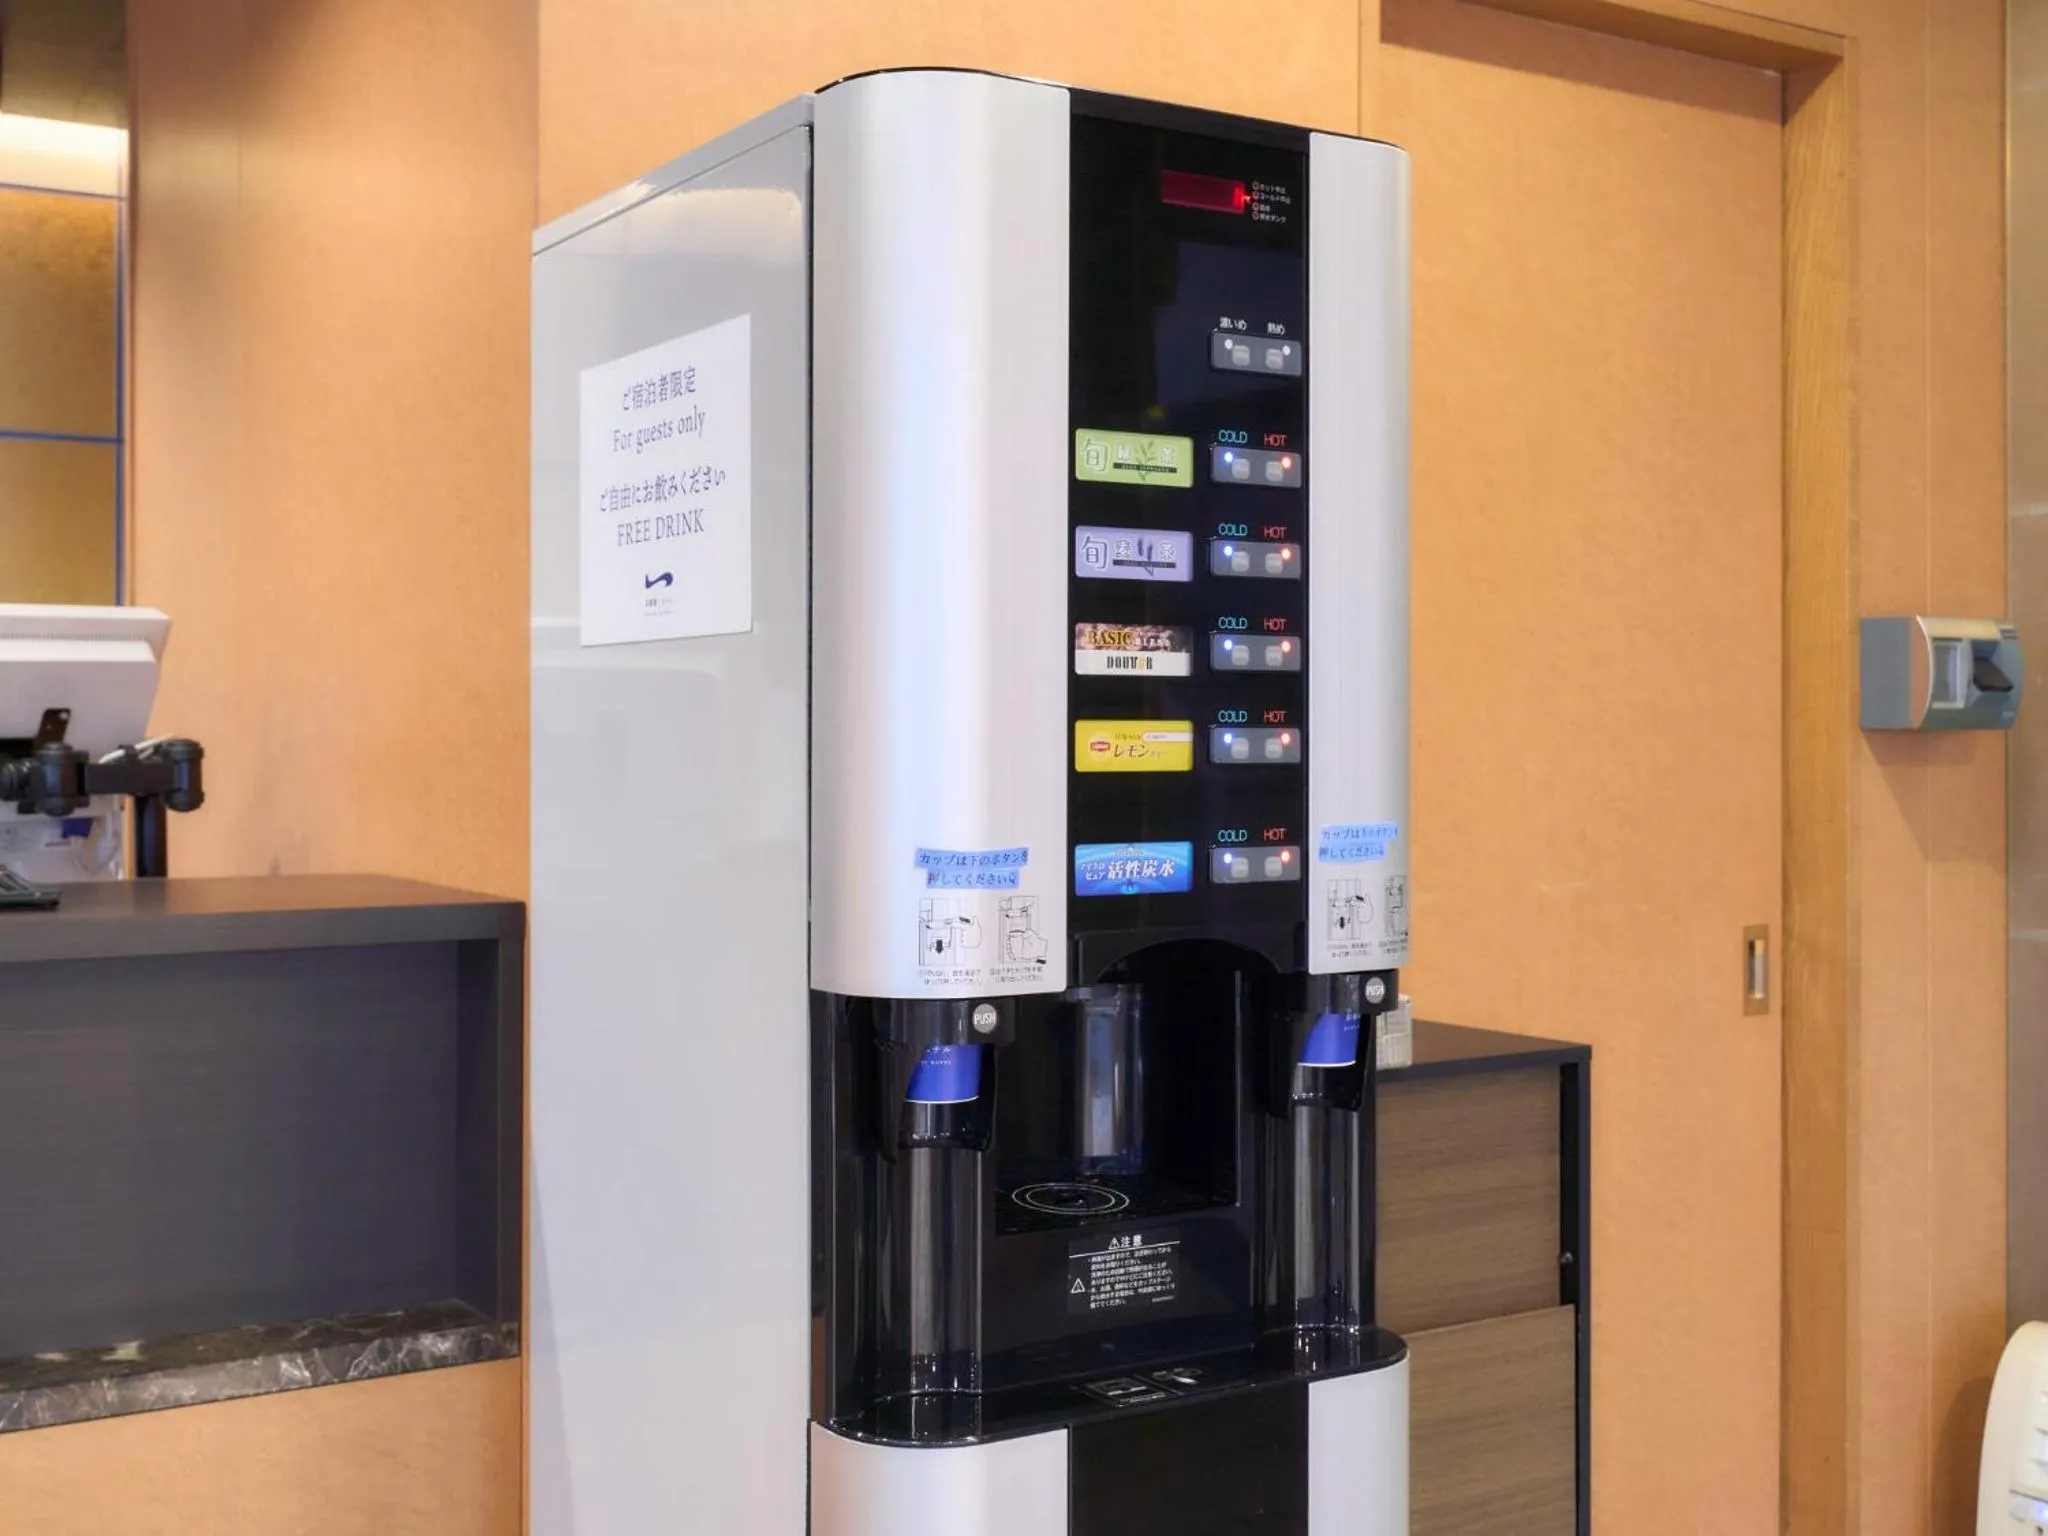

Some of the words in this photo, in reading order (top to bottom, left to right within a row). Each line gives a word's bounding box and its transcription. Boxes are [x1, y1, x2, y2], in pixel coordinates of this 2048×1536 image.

[622, 363, 696, 411] ご宿泊者限定
[613, 428, 633, 452] For
[636, 419, 674, 454] guests
[678, 404, 706, 438] only
[1218, 429, 1248, 444] COLD
[1263, 434, 1287, 447] HOT
[600, 465, 727, 512] ご自由にお飲みください
[617, 519, 651, 546] FREE
[656, 507, 705, 540] DRINK
[1218, 523, 1248, 537] COLD
[1263, 526, 1287, 539] HOT
[1218, 616, 1248, 629] COLD
[1263, 617, 1287, 630] HOT
[1087, 630, 1134, 646] BASIC
[1218, 709, 1248, 723] COLD
[1263, 710, 1287, 723] HOT
[1218, 829, 1248, 842] COLD
[1263, 828, 1287, 841] HOT
[1107, 858, 1176, 880] 活性炭水
[1366, 984, 1385, 996] PUSH
[974, 1012, 997, 1025] PUSH
